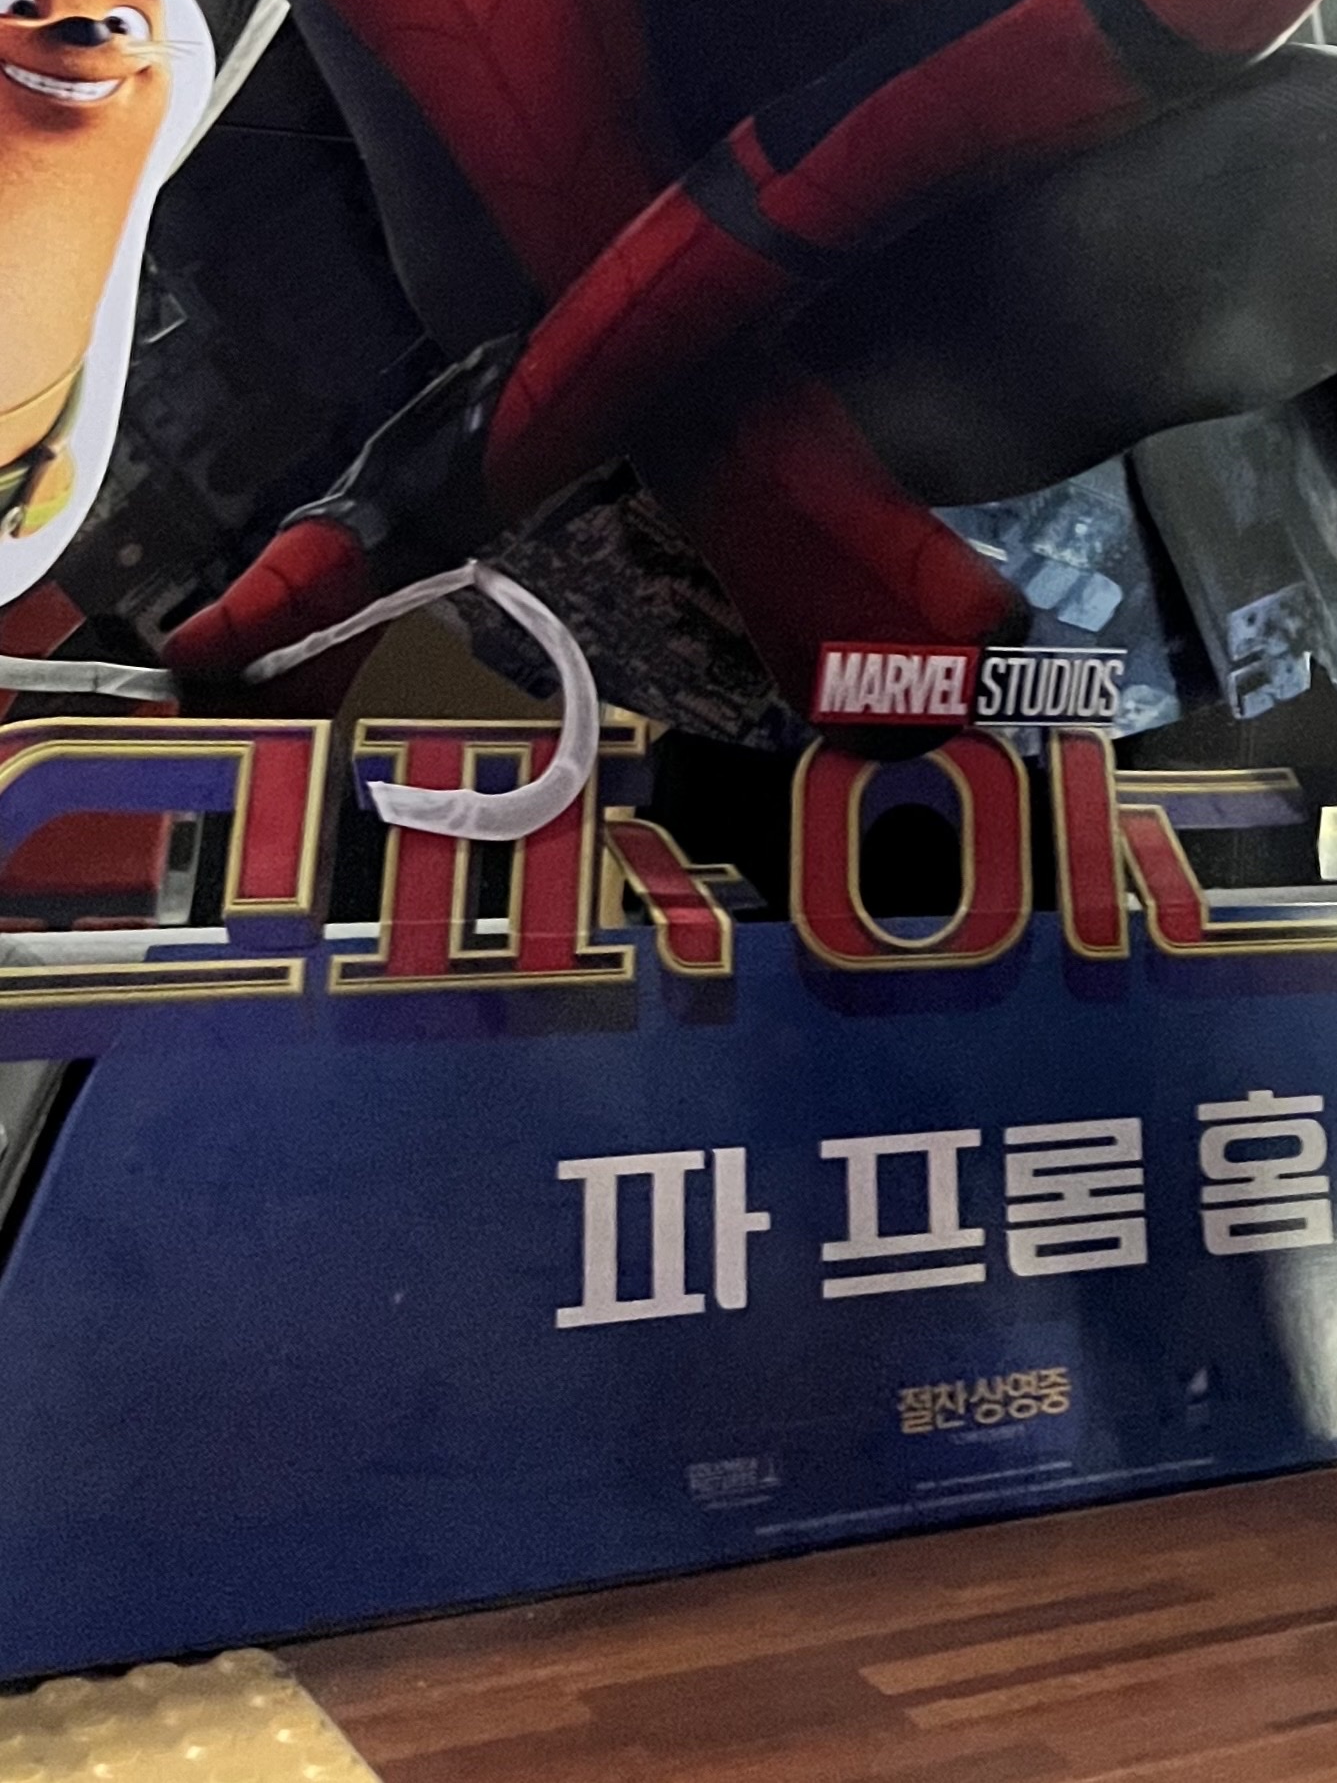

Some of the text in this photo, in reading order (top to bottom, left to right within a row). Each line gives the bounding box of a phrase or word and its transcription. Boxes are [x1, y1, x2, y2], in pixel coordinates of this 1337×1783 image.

[820, 652, 1123, 717] MARVEL STUDIOS
[556, 1089, 1333, 1329] 파 프롬 홈
